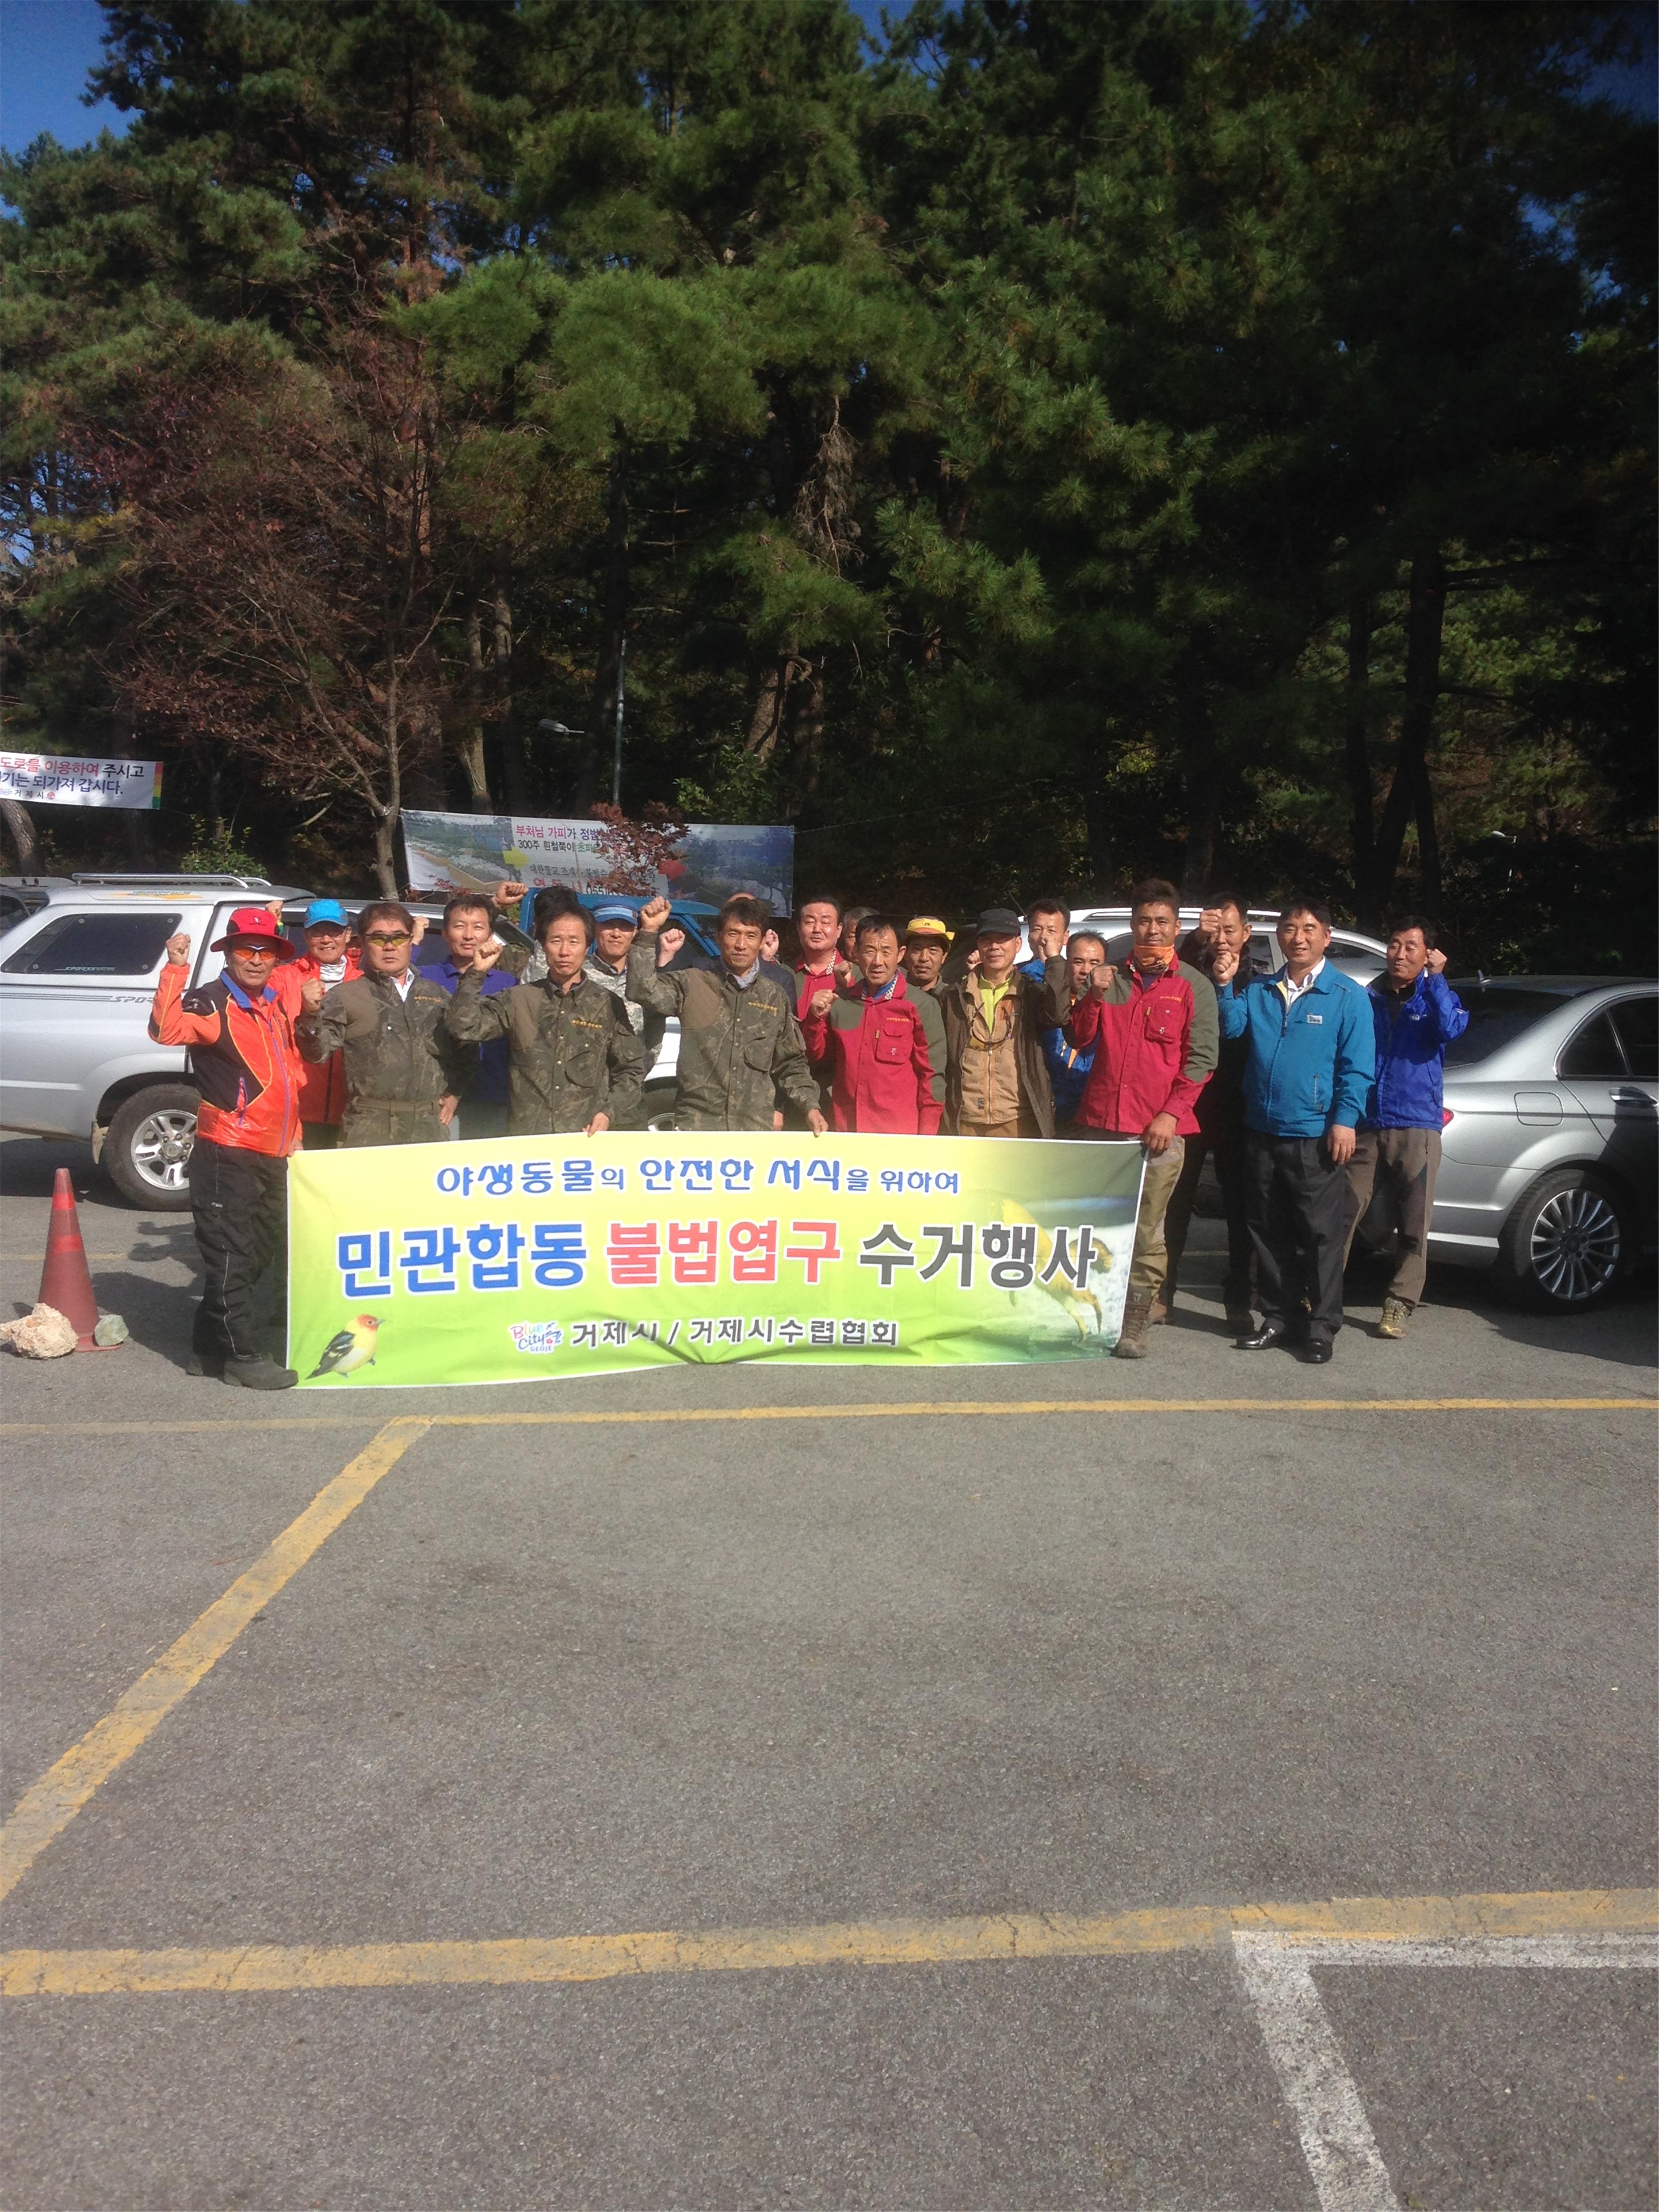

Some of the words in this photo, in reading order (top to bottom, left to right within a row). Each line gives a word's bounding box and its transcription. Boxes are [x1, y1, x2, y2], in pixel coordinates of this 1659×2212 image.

[0, 757, 40, 773] 도로를
[45, 760, 99, 777] 이용하여
[102, 764, 144, 779] 주시고
[0, 771, 30, 788] 기는
[33, 776, 75, 792] 되가져
[78, 779, 123, 794] 갑시다.
[516, 825, 544, 838] 부처님
[548, 827, 576, 840] 가피가
[518, 840, 540, 850] 300주
[437, 1159, 625, 1196] 야생동물의
[639, 1159, 754, 1191] 안전한
[767, 1159, 869, 1192] 서식을
[880, 1170, 959, 1194] 위하여
[337, 1223, 588, 1297] 민관합동
[607, 1221, 841, 1285] 불법엽구
[859, 1222, 1096, 1289] 수거행사
[510, 1323, 543, 1339] Blue
[518, 1334, 544, 1350] City
[571, 1320, 657, 1347] 거제시
[689, 1319, 898, 1346] 거제시수렵협회
